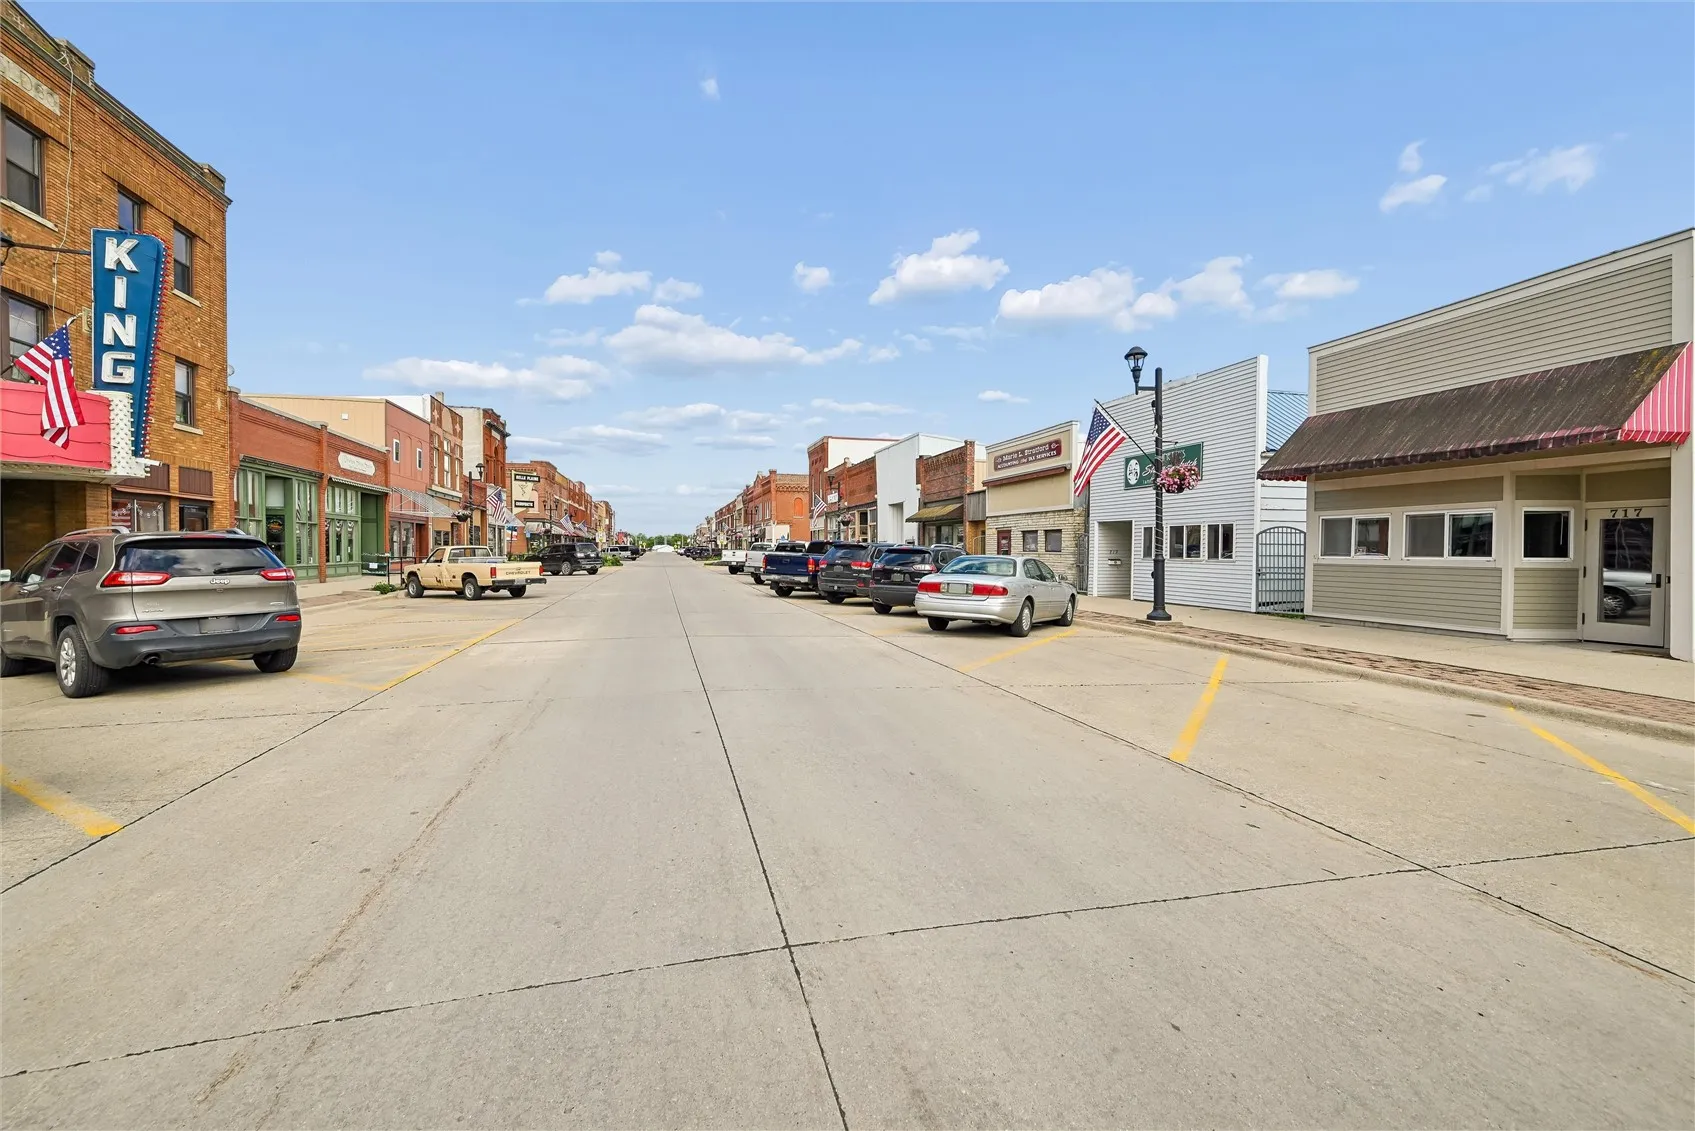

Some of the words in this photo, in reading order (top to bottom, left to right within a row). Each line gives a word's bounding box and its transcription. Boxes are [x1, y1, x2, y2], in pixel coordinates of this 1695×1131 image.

[102, 237, 139, 384] KING
[1036, 450, 1057, 460] SERVICES
[1610, 508, 1642, 518] 717
[210, 578, 230, 586] Jeep
